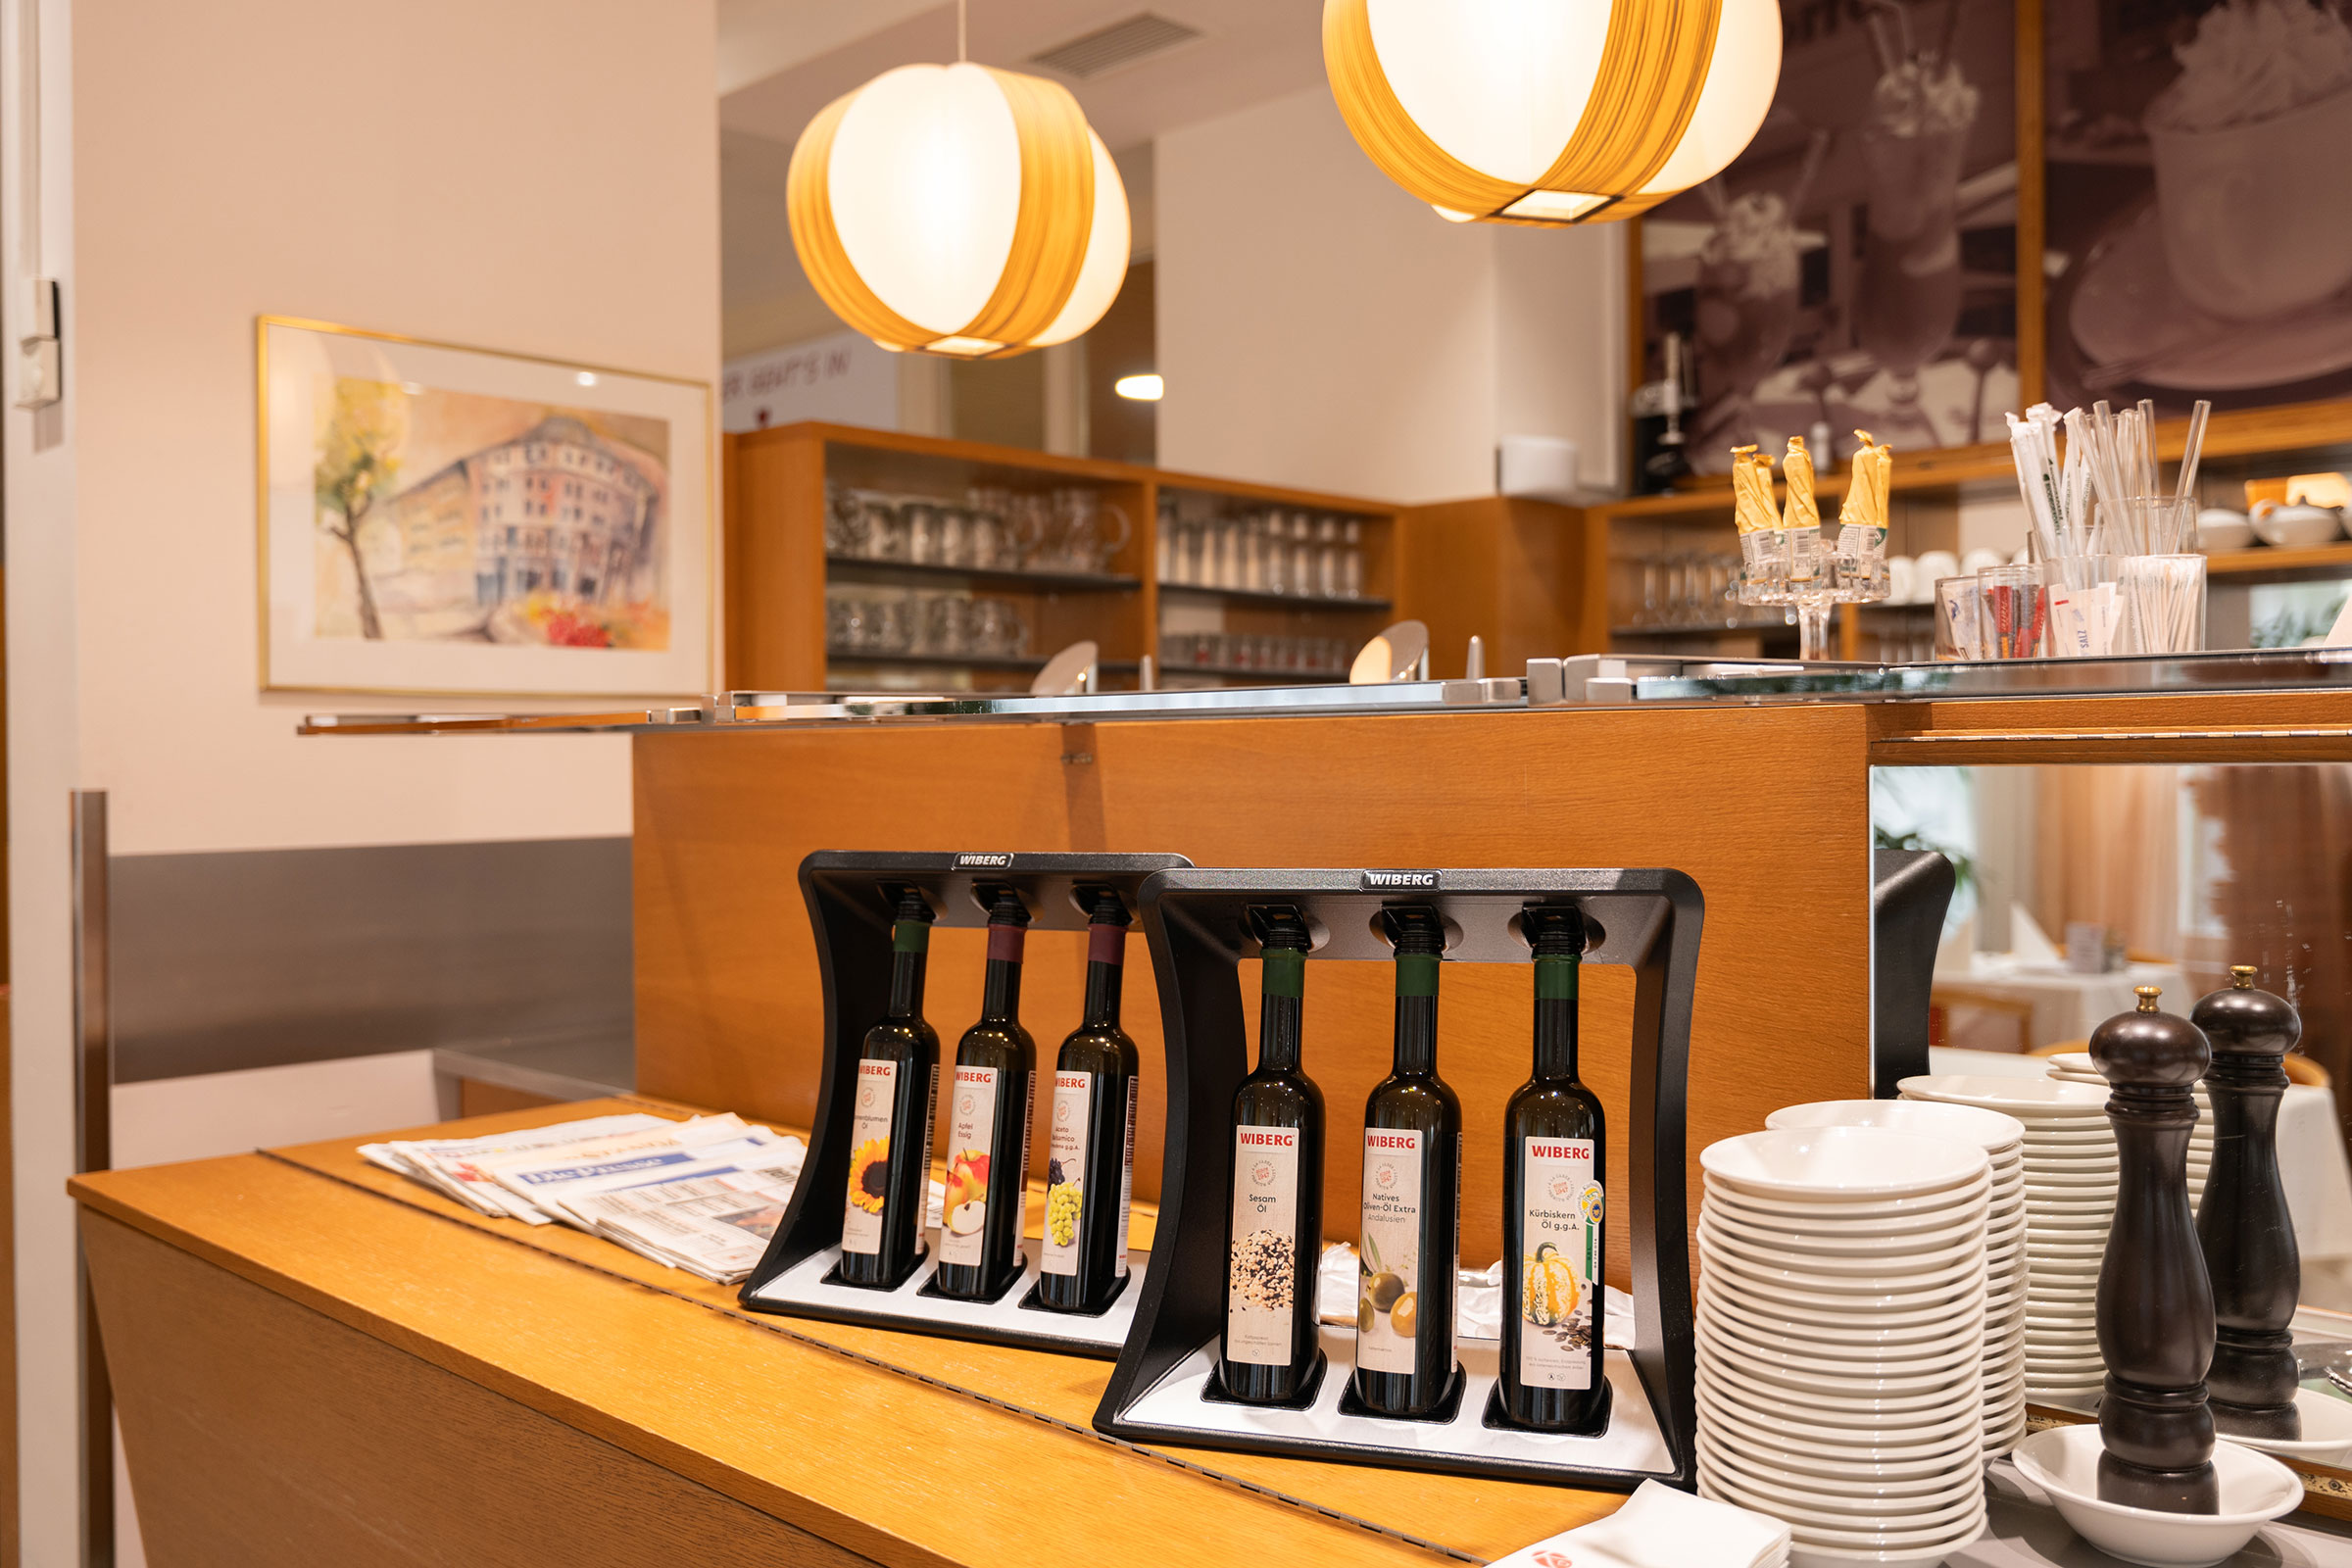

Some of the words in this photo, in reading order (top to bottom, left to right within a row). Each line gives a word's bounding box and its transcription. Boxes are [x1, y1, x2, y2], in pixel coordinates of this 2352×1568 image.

[2079, 629, 2089, 649] SALZ
[959, 855, 1006, 866] WIBERG
[1369, 872, 1434, 886] WIBERG
[957, 1131, 971, 1140] Essig
[1240, 1133, 1294, 1147] WIBERG
[1367, 1135, 1415, 1150] WIBERG
[1532, 1145, 1590, 1160] WIBERG
[1249, 1194, 1277, 1203] Sesam
[1372, 1193, 1399, 1202] Natives
[1256, 1204, 1267, 1213] Öl
[1394, 1204, 1416, 1213] Extra
[1367, 1213, 1405, 1224] Andalusien
[1529, 1209, 1576, 1220] Kürbiskern
[1541, 1219, 1551, 1230] Öl
